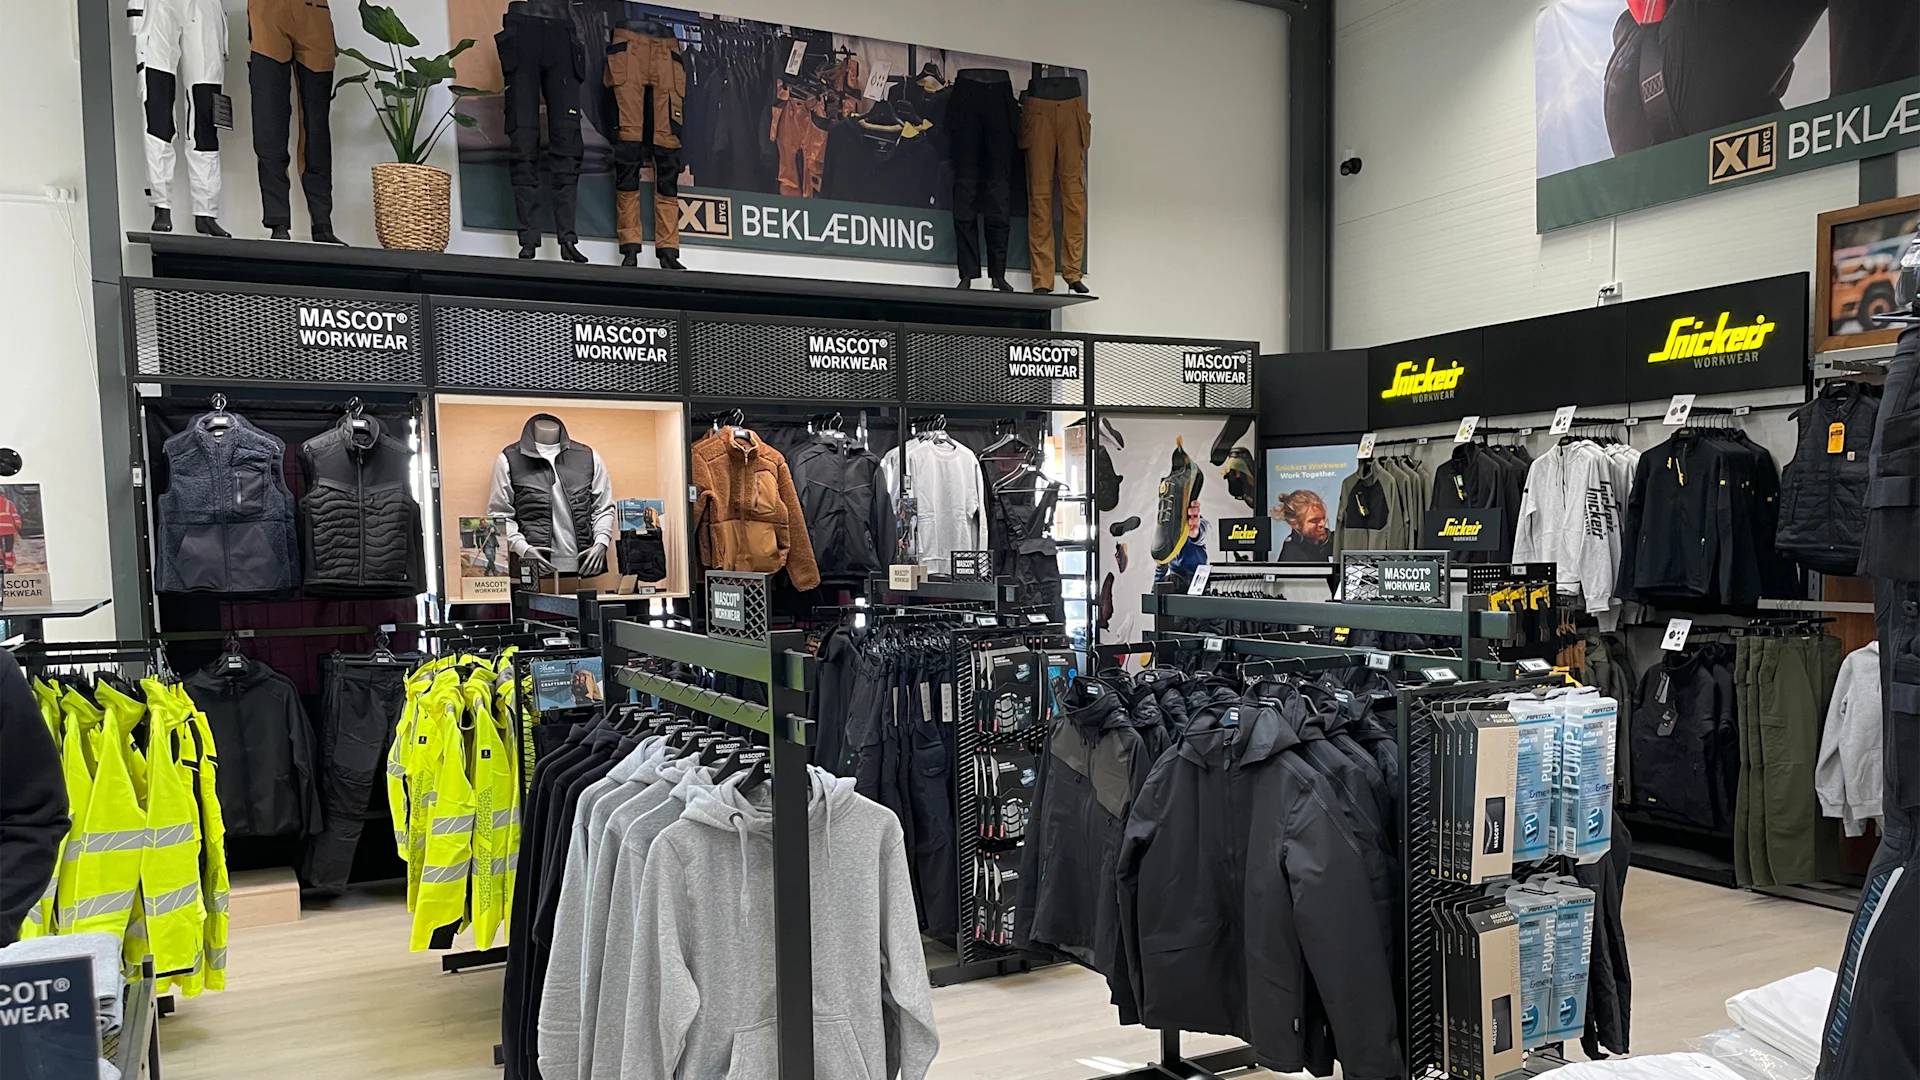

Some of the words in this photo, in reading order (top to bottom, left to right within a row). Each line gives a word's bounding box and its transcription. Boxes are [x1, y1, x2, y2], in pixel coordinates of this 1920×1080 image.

[1713, 132, 1771, 178] XL
[678, 199, 728, 234] XL
[741, 204, 935, 251] BEKLÆDNING
[299, 329, 408, 350] WORKWEAR
[1647, 311, 1775, 364] Snickers
[575, 343, 668, 362] WORKWEAR
[808, 353, 888, 371] WORKWEAR
[1693, 351, 1760, 369] WORKWEAR
[1009, 362, 1078, 378] WORKWEAR
[1184, 368, 1246, 384] WORKWEAR
[1381, 357, 1465, 399] Snickers
[1411, 390, 1455, 404] WORKWEAR
[1301, 470, 1337, 478] Together.
[1437, 517, 1482, 536] Snickers
[4, 579, 42, 588] SCOT®
[1384, 580, 1431, 592] WORKWEAR
[4, 589, 43, 598] RKWEAR
[714, 608, 741, 622] WORKWEAR
[1541, 726, 1554, 782] PUMP-IT
[1606, 720, 1617, 775] PUMP-IT
[1542, 918, 1556, 972] PUMP-IT
[1580, 911, 1594, 964] PUMP-IT
